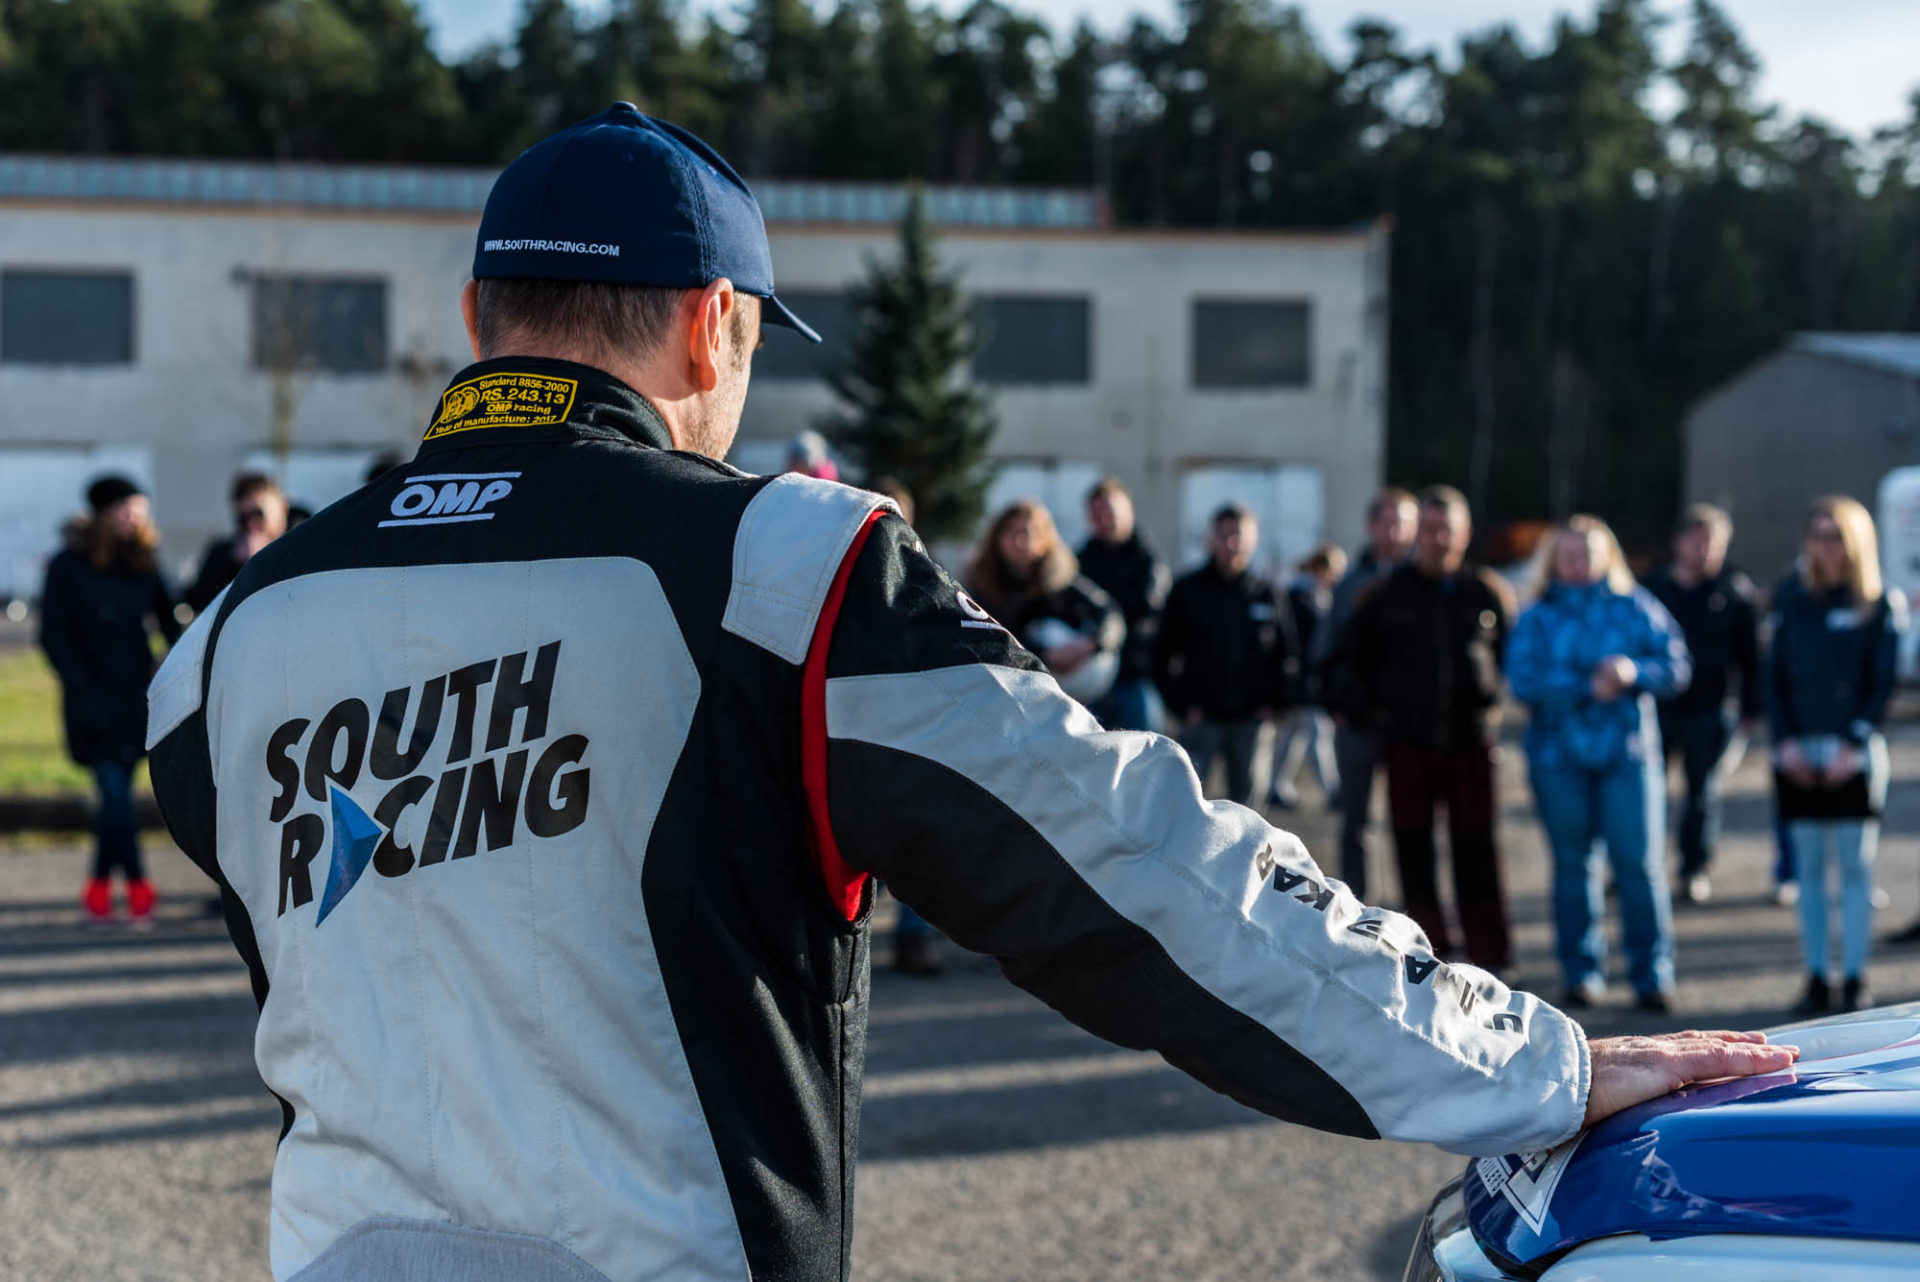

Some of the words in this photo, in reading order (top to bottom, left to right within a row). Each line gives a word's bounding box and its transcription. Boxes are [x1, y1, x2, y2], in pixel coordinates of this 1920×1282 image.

[484, 239, 620, 257] WWW.SOUTHRACING.COM
[479, 377, 517, 390] Standard
[518, 377, 570, 393] 8856-2000
[486, 402, 513, 413] OMP
[513, 404, 552, 415] racing
[435, 423, 452, 434] Year
[453, 419, 462, 430] of
[464, 414, 530, 426] manufacture:
[389, 478, 515, 519] OMP
[266, 640, 562, 823] SOUTH
